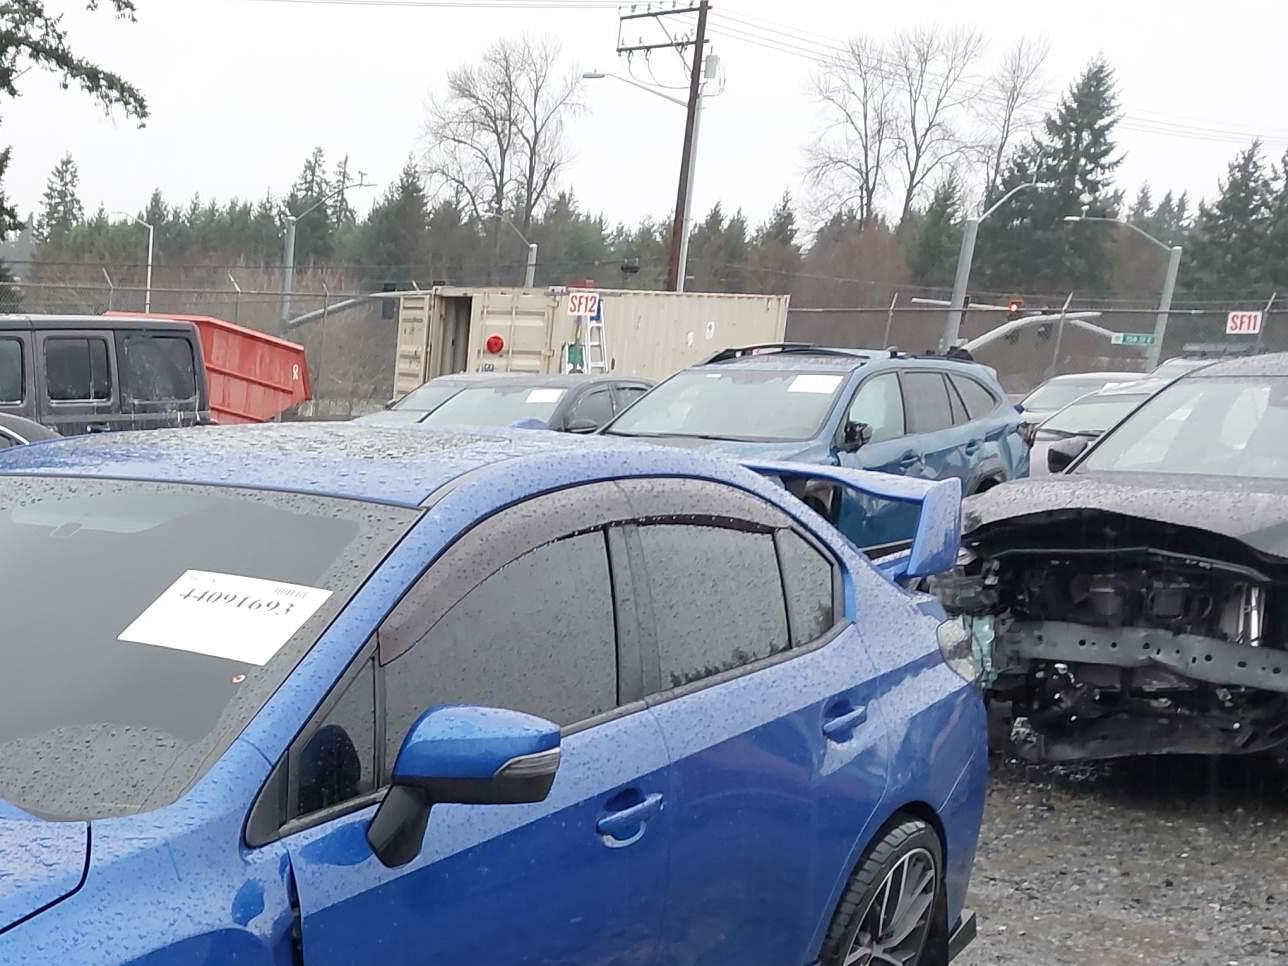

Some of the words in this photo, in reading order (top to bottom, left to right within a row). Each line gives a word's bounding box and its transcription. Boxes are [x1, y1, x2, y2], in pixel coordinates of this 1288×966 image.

[569, 294, 597, 313] SF12
[1230, 314, 1257, 332] SF11
[178, 588, 295, 615] 44091693
